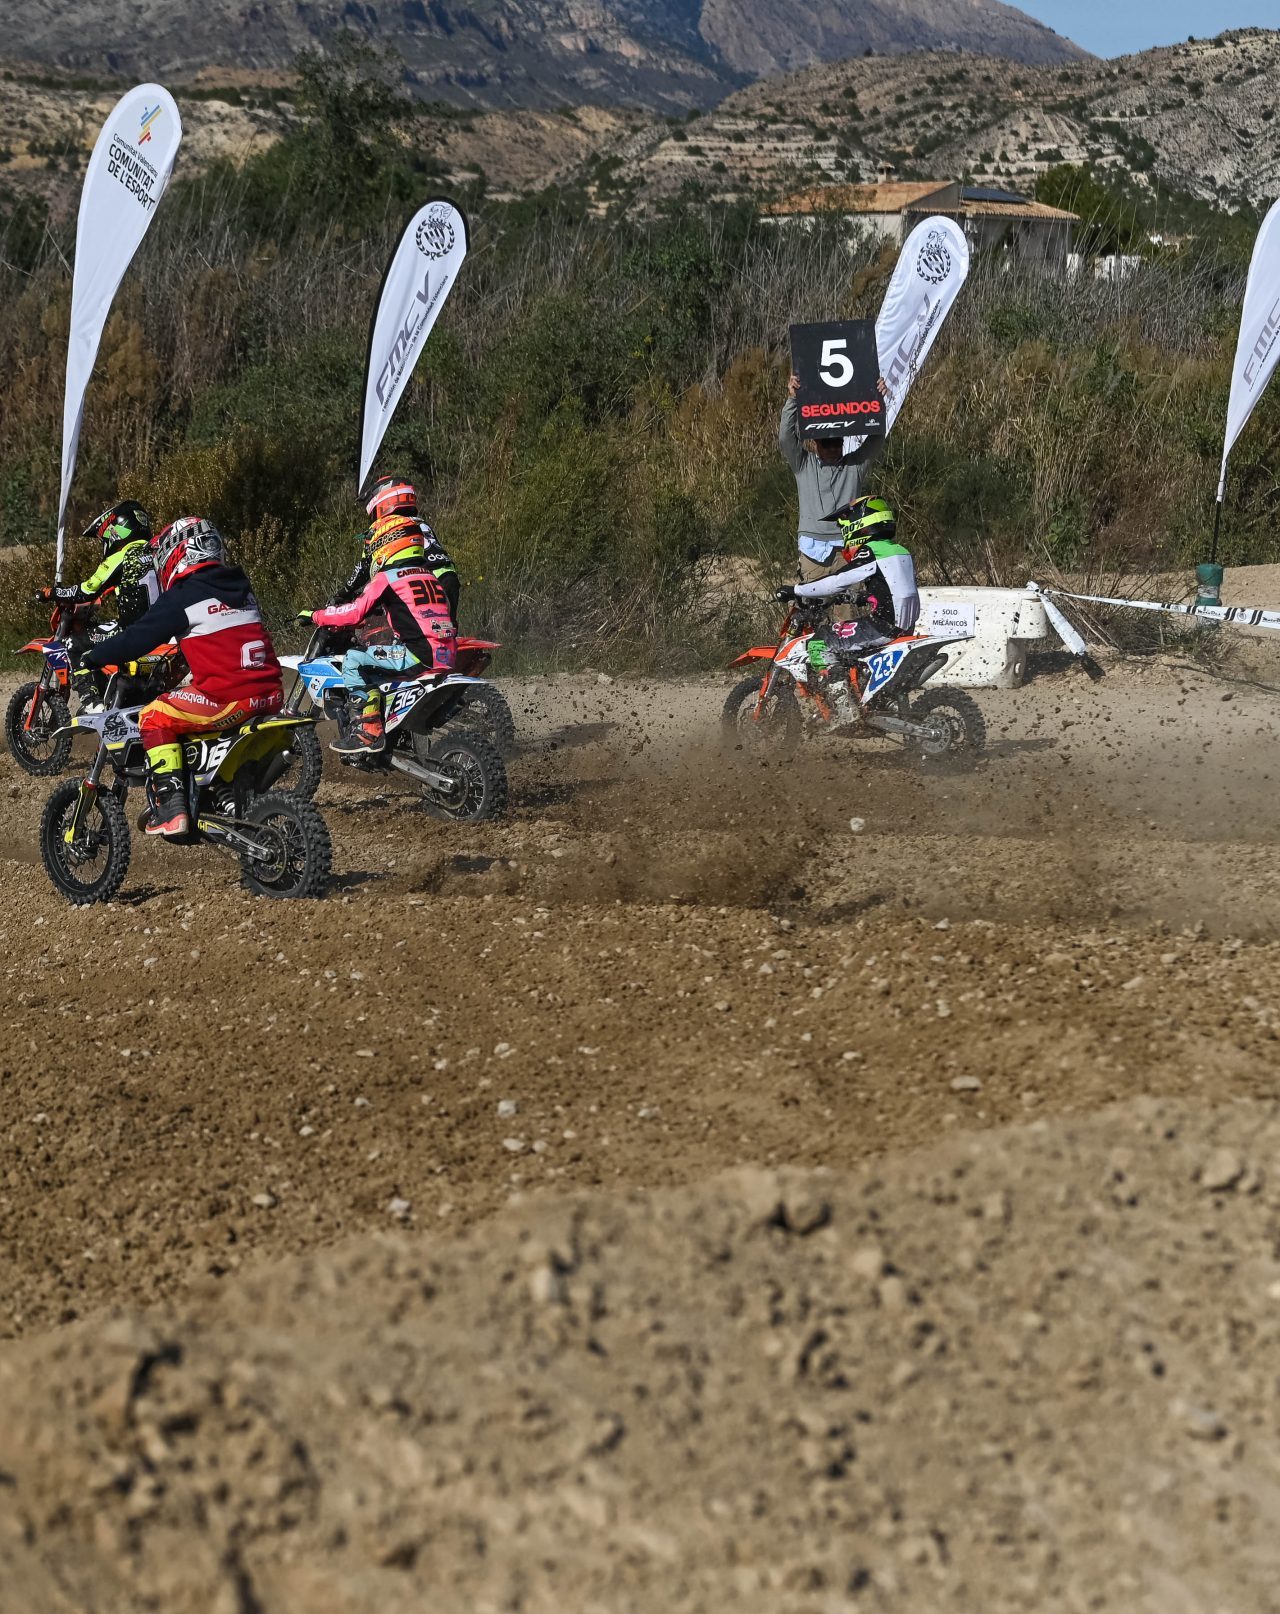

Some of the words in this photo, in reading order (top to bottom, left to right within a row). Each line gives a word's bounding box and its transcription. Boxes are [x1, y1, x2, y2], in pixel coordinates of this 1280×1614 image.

[109, 144, 154, 191] COMUNITAT
[108, 160, 121, 178] DE
[120, 170, 155, 211] L'ESPORT
[819, 338, 854, 388] 5
[801, 400, 881, 418] SEGUNDOS
[805, 420, 856, 430] FMCV
[408, 579, 448, 606] 315
[392, 688, 417, 711] 315
